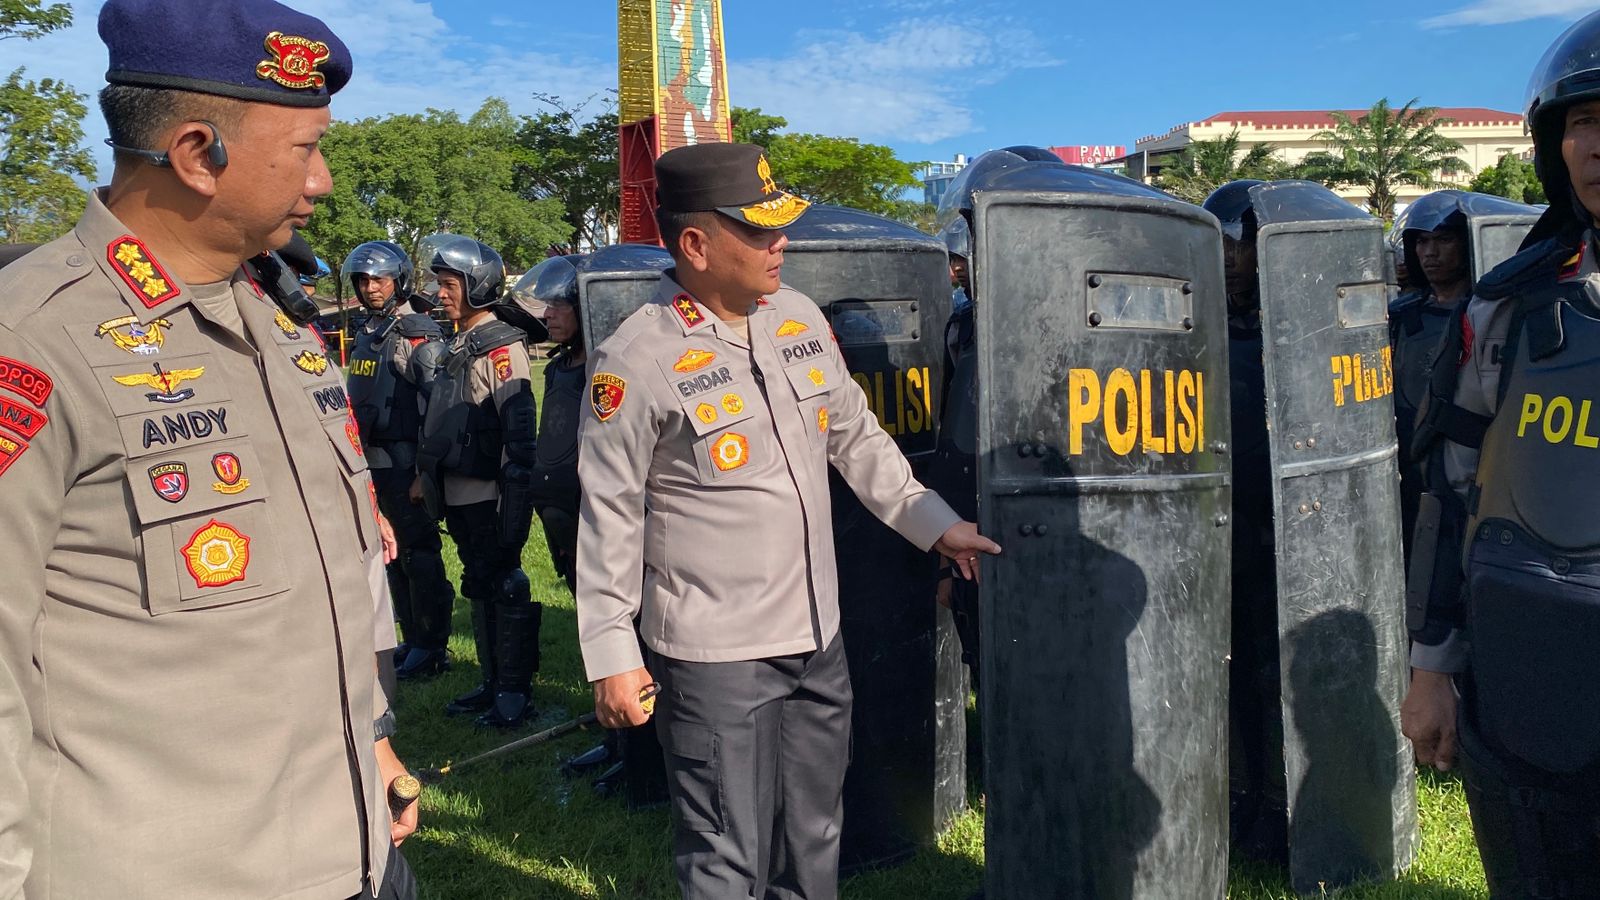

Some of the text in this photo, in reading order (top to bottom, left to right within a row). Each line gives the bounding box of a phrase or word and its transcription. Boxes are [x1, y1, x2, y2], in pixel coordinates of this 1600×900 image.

[1080, 145, 1116, 157] PAM
[1080, 156, 1116, 164] TOWE
[782, 339, 824, 363] POLRI
[0, 364, 46, 396] OPOR
[350, 358, 377, 377] OLISI
[677, 366, 733, 398] ENDAR
[0, 402, 32, 429] NA
[851, 366, 931, 434] OLISI
[1068, 367, 1204, 456] POLISI
[142, 406, 228, 449] ANDY
[1517, 393, 1600, 449] POL
